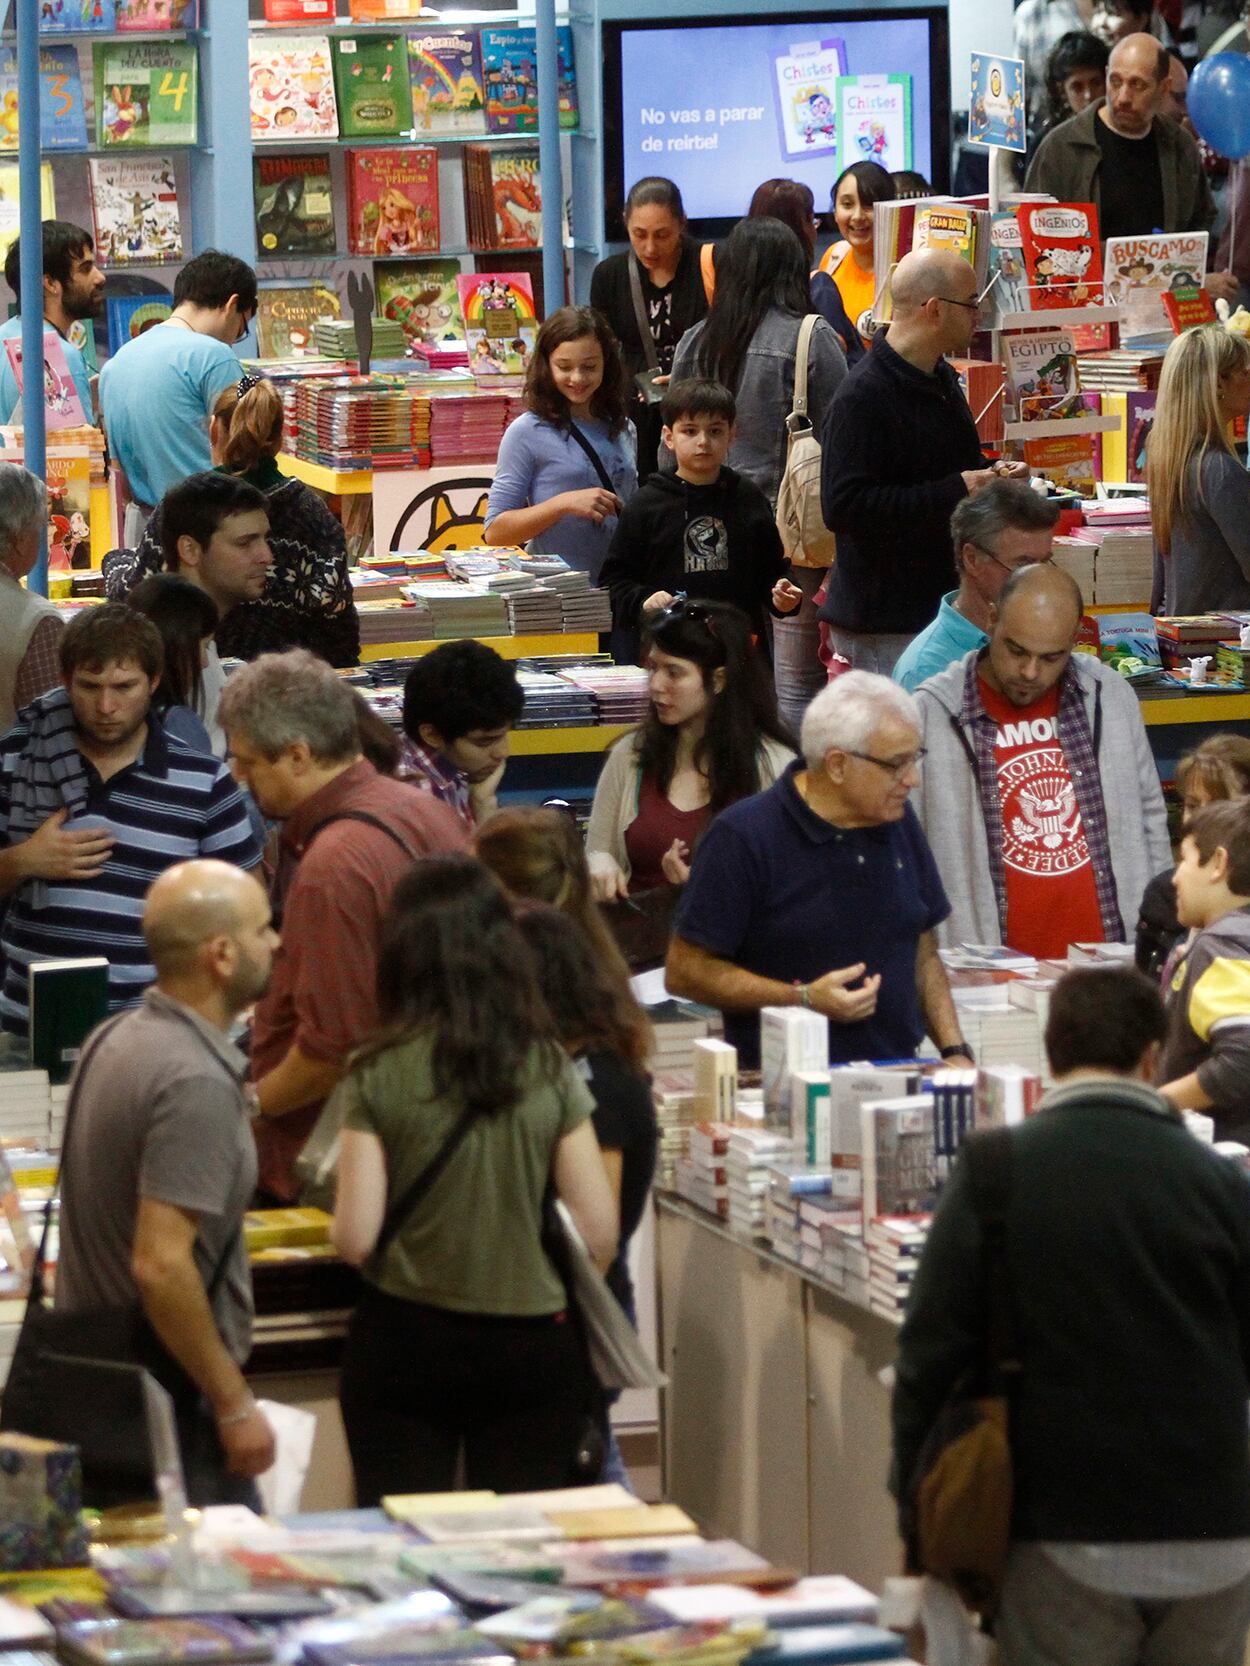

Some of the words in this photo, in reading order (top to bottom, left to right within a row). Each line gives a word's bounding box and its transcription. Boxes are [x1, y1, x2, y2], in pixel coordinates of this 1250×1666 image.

[783, 63, 833, 80] Chistes
[47, 74, 73, 116] 3
[158, 71, 189, 112] 4
[847, 96, 897, 109] Chistes
[640, 108, 666, 125] No
[669, 109, 701, 123] vas
[704, 108, 716, 122] a
[719, 106, 765, 126] parar
[641, 136, 663, 152] de
[1034, 216, 1086, 229] INGENIOS
[1010, 341, 1072, 358] EGIPTO
[46, 460, 76, 469] ARDO
[996, 716, 1059, 749] AMO
